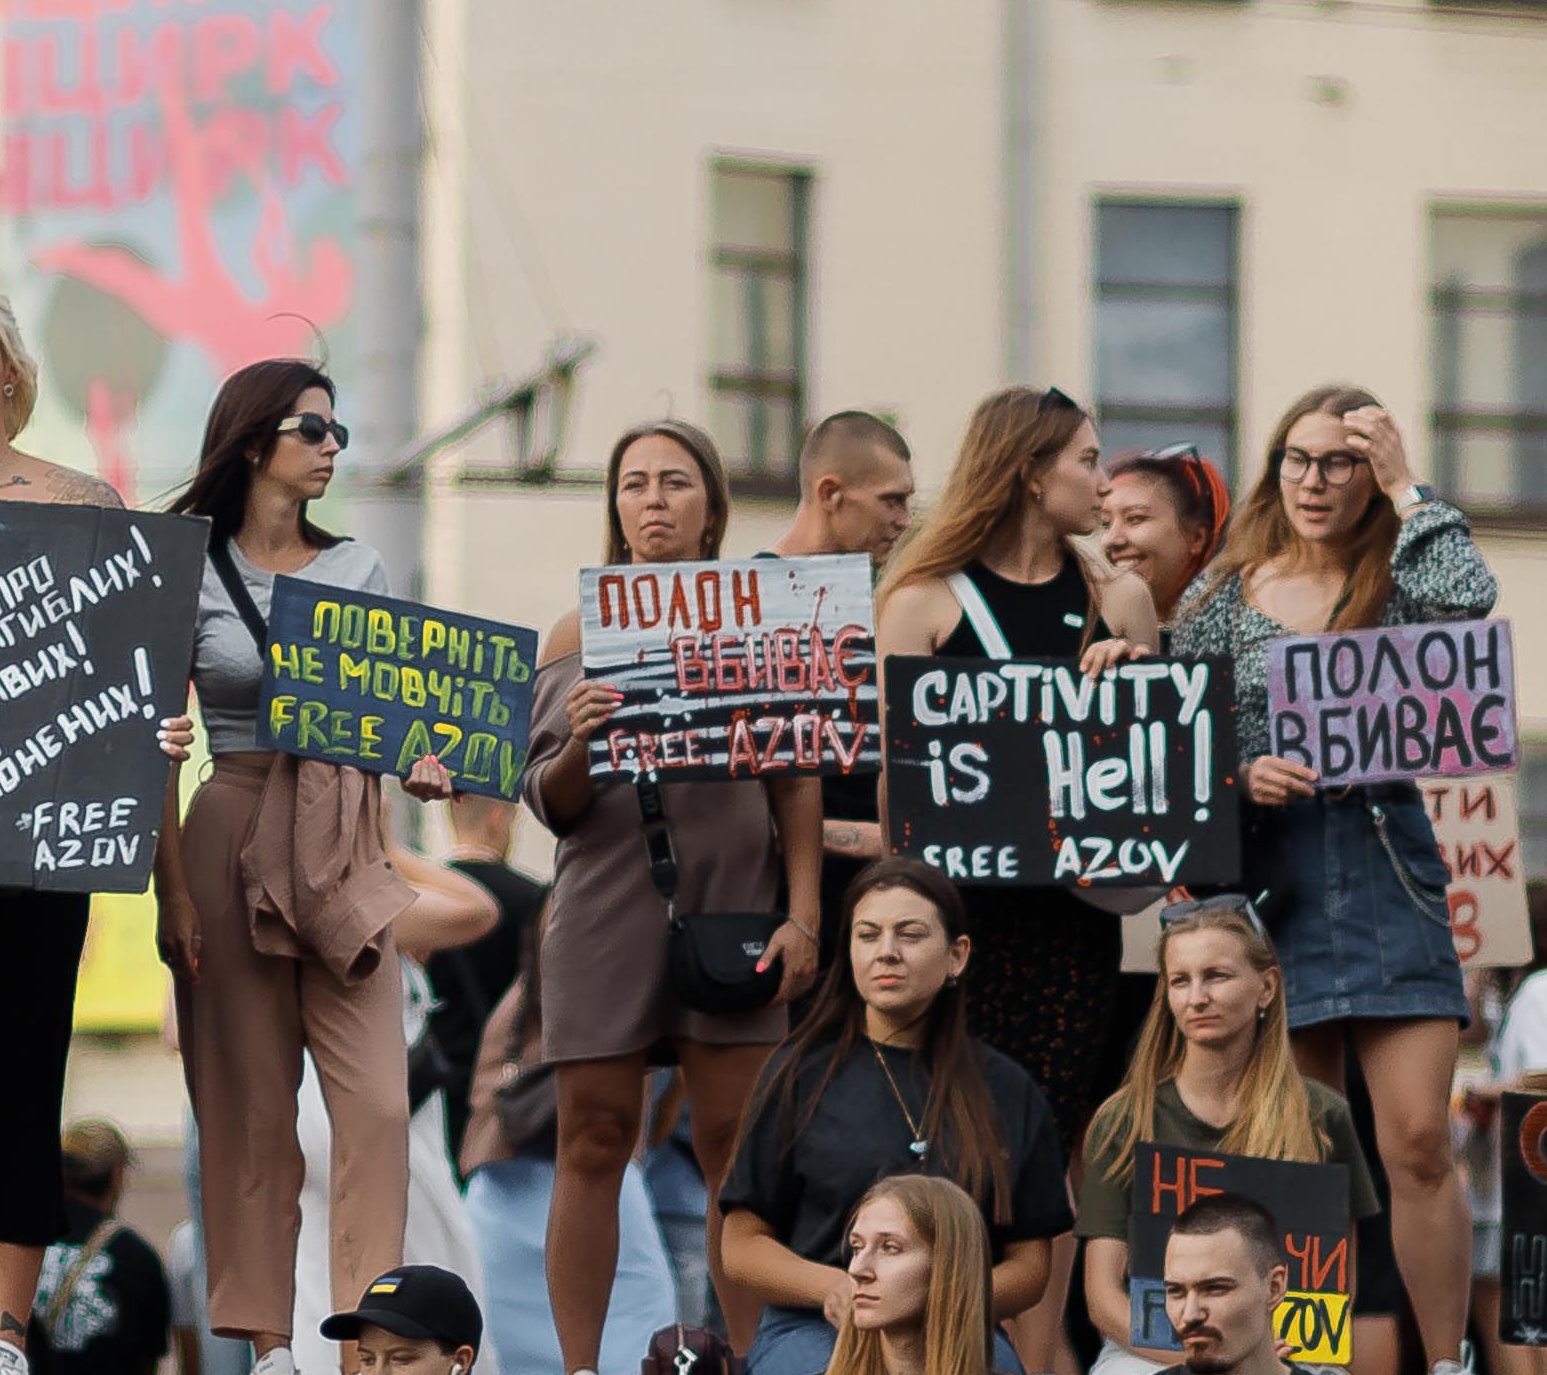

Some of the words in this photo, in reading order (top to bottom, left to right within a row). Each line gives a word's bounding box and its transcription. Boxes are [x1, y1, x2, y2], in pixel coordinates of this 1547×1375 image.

[598, 568, 762, 631] ПОЛОН
[270, 643, 324, 684] НЕ
[672, 624, 870, 693] ВБИВАЄ
[1285, 625, 1501, 703] ПОЛОН
[270, 695, 386, 759] FREE
[396, 719, 526, 798] AZOV
[607, 729, 705, 771] FREE
[728, 714, 868, 777] AZOV
[1275, 694, 1512, 778] ВБИВАЄ
[34, 834, 140, 872] AZOV
[923, 844, 1019, 878] FREE
[1053, 836, 1190, 882] AZOV
[1152, 1151, 1226, 1216] НЕ
